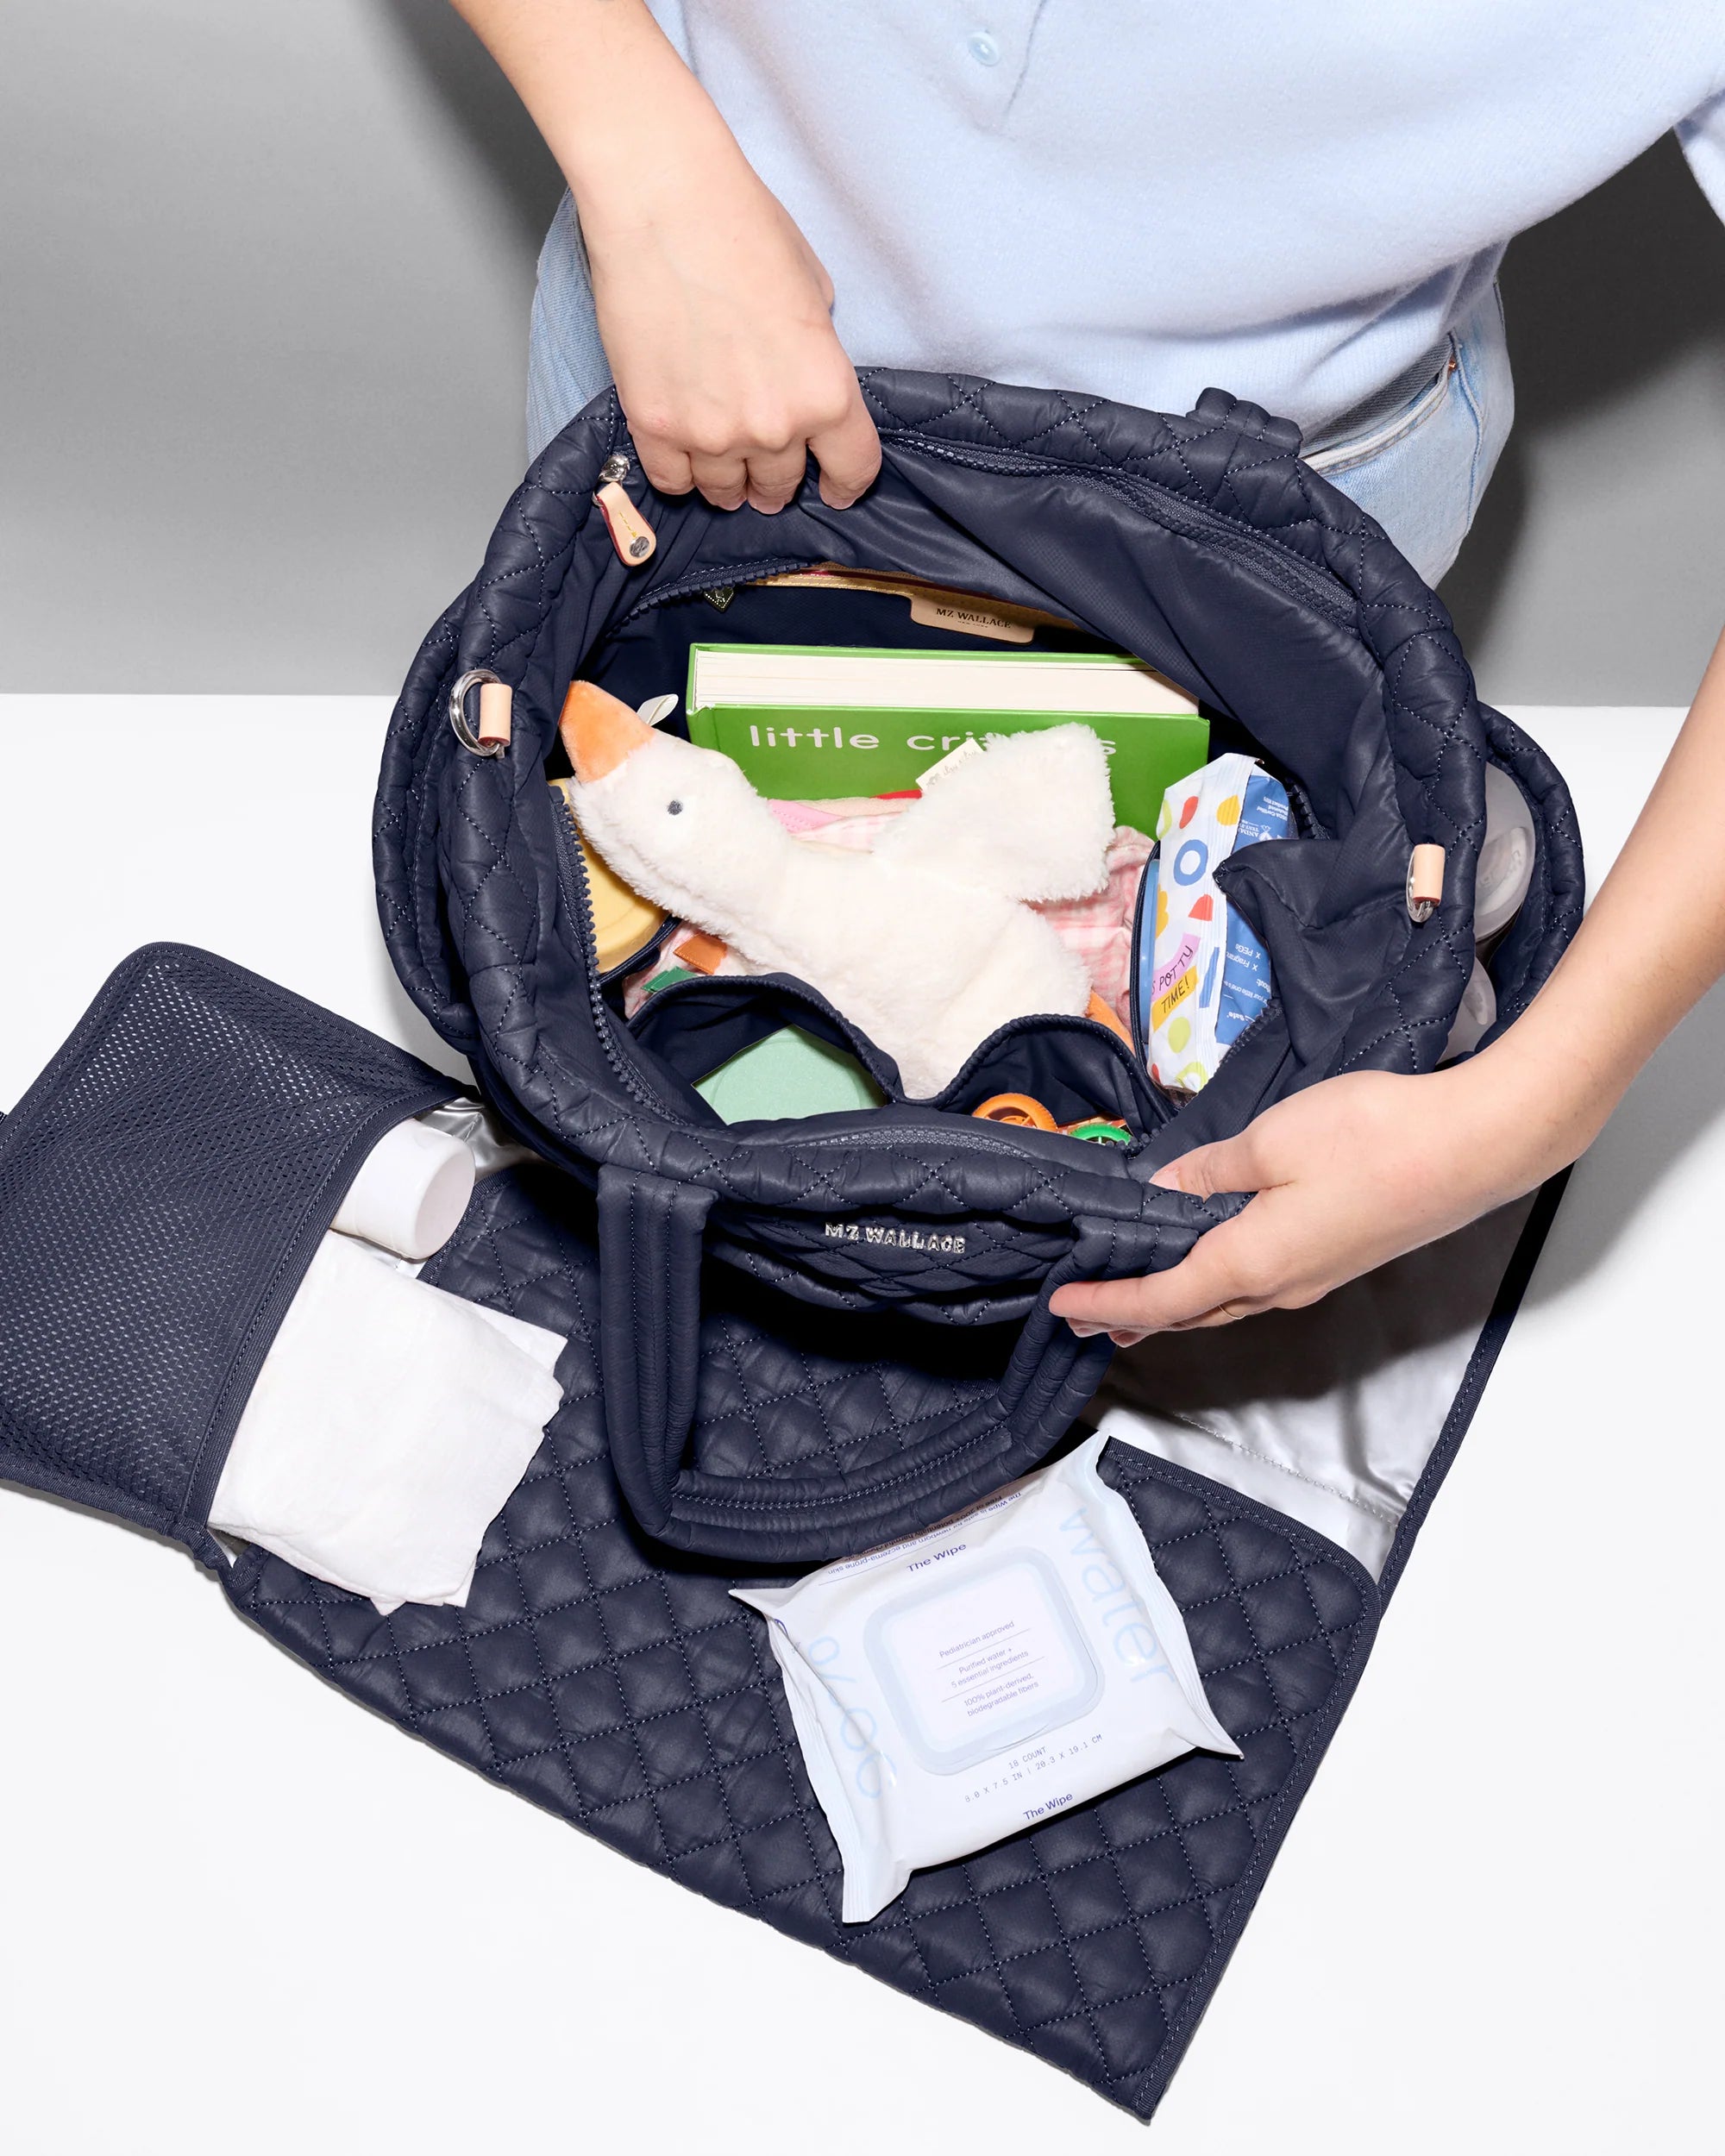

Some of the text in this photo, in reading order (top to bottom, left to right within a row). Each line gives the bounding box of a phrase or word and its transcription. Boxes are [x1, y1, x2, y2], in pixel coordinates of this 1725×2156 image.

[936, 607, 954, 617] MZ
[957, 611, 1011, 629] WALLACE
[750, 725, 880, 749] little
[1158, 945, 1194, 991] POTTY
[1162, 975, 1190, 1013] TIME!
[825, 1222, 965, 1253] MZ WALLACE
[845, 1545, 901, 1570] eczema-prone
[902, 1540, 918, 1549] and
[906, 1543, 967, 1573] The Wipe
[828, 1564, 844, 1575] skin
[1059, 1507, 1176, 1683] water
[939, 1620, 1014, 1658] Pediatrician approved
[957, 1667, 989, 1686] essential
[989, 1650, 1029, 1672] ingredients
[958, 1658, 987, 1674] Purified
[987, 1649, 1007, 1663] water
[964, 1694, 986, 1707] 100%
[967, 1681, 1039, 1717] biodegradable fibers
[1012, 1772, 1023, 1782] IN
[1091, 1733, 1103, 1744] CM
[1022, 1746, 1047, 1763] COUNT
[1023, 1792, 1074, 1821] The Wipe
